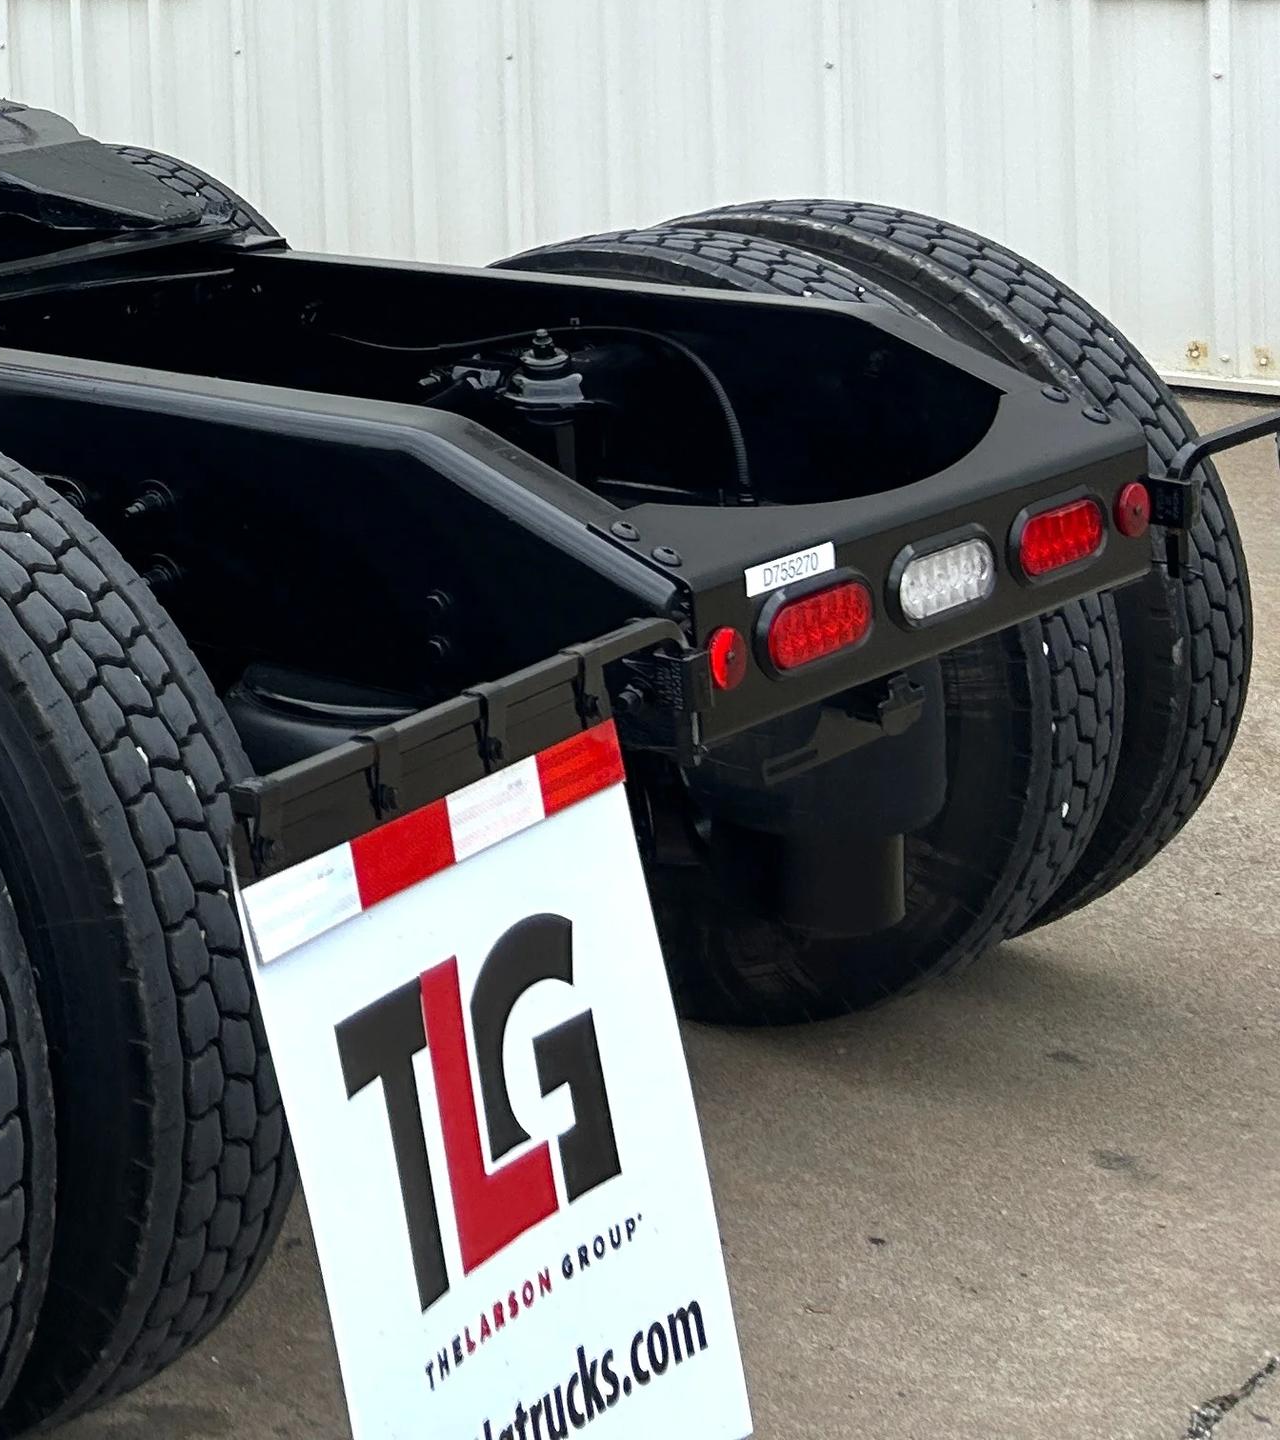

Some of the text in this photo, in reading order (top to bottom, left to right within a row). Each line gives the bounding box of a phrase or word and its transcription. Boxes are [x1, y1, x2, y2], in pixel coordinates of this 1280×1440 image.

[763, 552, 819, 587] D755270
[334, 913, 622, 1314] TLG
[561, 1217, 637, 1280] GROUP
